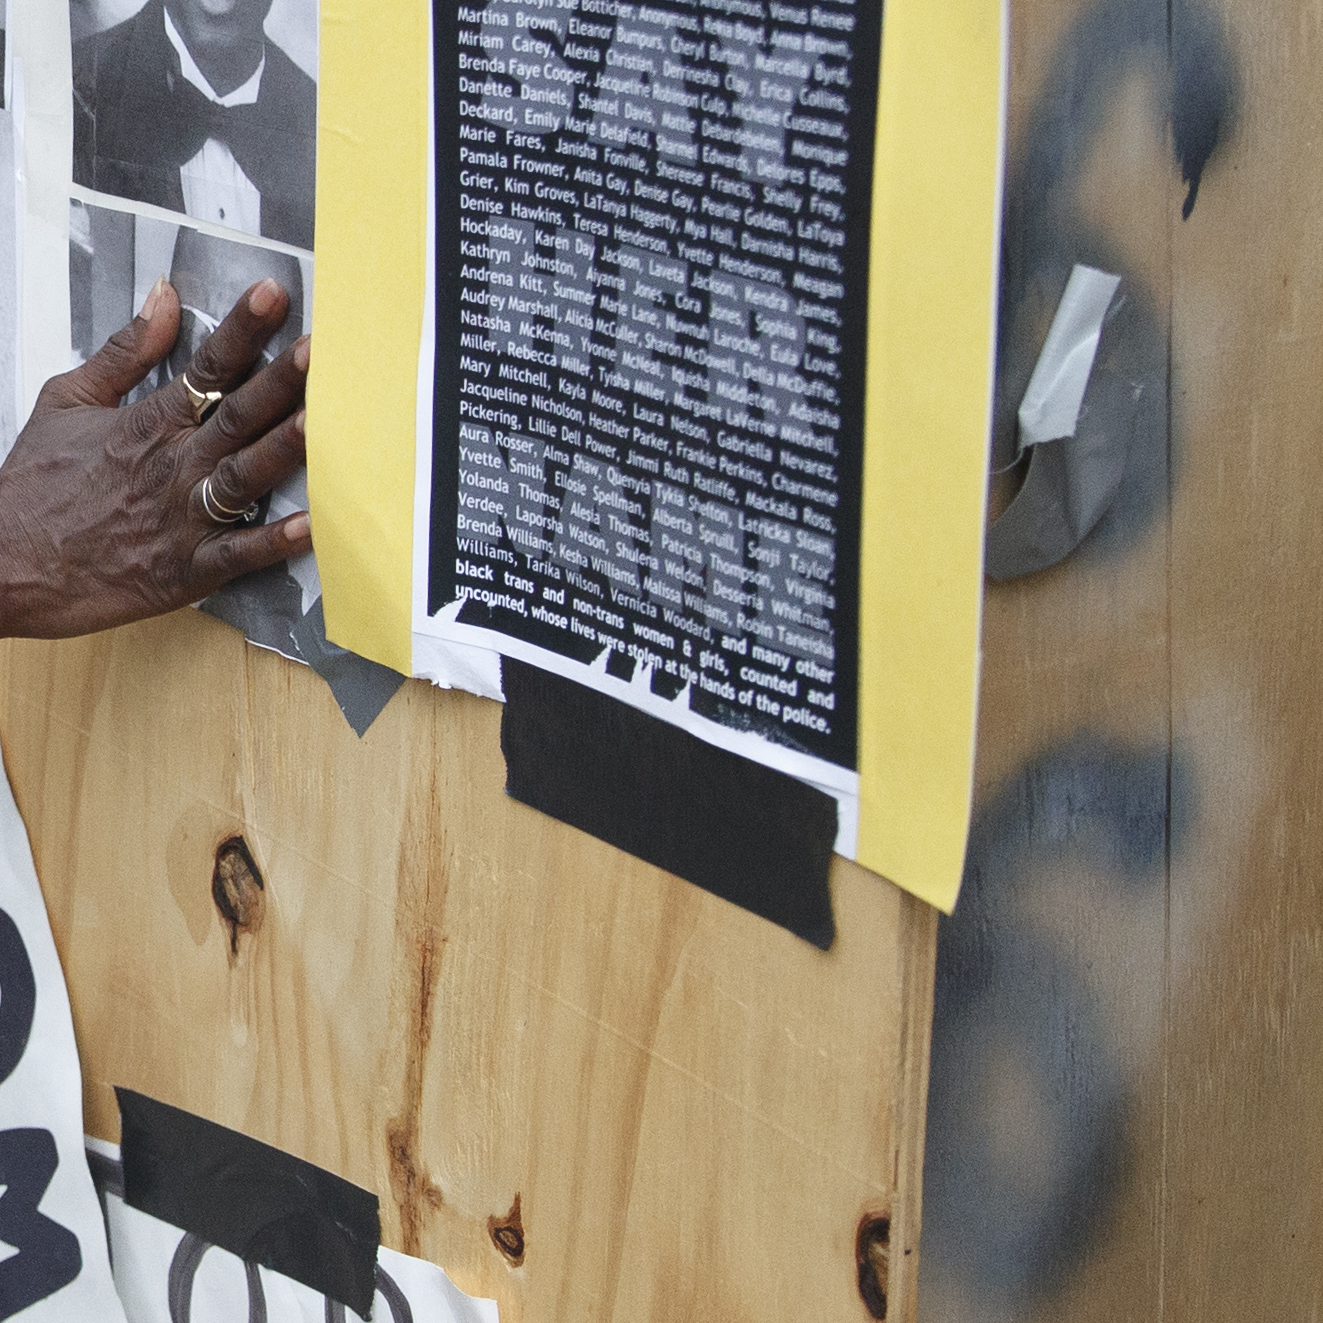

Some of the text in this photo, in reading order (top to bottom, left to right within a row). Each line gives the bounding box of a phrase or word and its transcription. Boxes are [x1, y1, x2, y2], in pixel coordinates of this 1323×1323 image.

[457, 5, 612, 40] Martina Brown, Eleanor
[457, 28, 556, 60] Miriam Carey,
[458, 52, 591, 88] Brenda Faye Cooper,
[459, 76, 572, 110] Danette Daniels,
[459, 99, 561, 134] Deckard, Emily
[459, 122, 546, 154] Marie Fares,
[459, 145, 603, 186] Pamala Frowner, Anita
[459, 169, 579, 208] Grier, Kim Groves,
[460, 192, 609, 237] Denise Hawkins, Teresa
[460, 215, 596, 262] Hockaday, Karen Day
[460, 238, 578, 280] Kathryn Johnston,
[460, 261, 596, 307] Andrena Kitt, Summer
[460, 285, 594, 330] Audrey Marshall, Alicia
[460, 307, 617, 362] Natasha McKenna, Yvonne
[460, 330, 558, 368] Miller, Rebecca
[459, 354, 587, 402] Mary Mitchell, Kayla
[459, 398, 581, 446] Pickering, Lillie Dell
[460, 375, 630, 440] Jacqueline Nicholson, Heather
[458, 443, 502, 470] Yvette
[509, 456, 548, 484] Smith,
[459, 422, 570, 466] Aura Rosser, Alma
[458, 466, 510, 496] Yolanda
[519, 482, 564, 513] Thomas,
[457, 489, 610, 554] Verdee, Laporsha Watson,
[457, 511, 589, 568] Brenda Williams, Kesha
[456, 533, 834, 686] Williams, Tarika Wilson, and many other
[455, 556, 835, 711] black trans and non-trans women & girls, counted and
[531, 606, 568, 630] whose
[571, 617, 596, 640] lives
[597, 633, 626, 653] were
[665, 661, 678, 676] at
[679, 664, 698, 684] the
[700, 672, 736, 700] hands
[738, 689, 754, 707] of
[756, 695, 780, 717] the
[783, 706, 831, 735] police.
